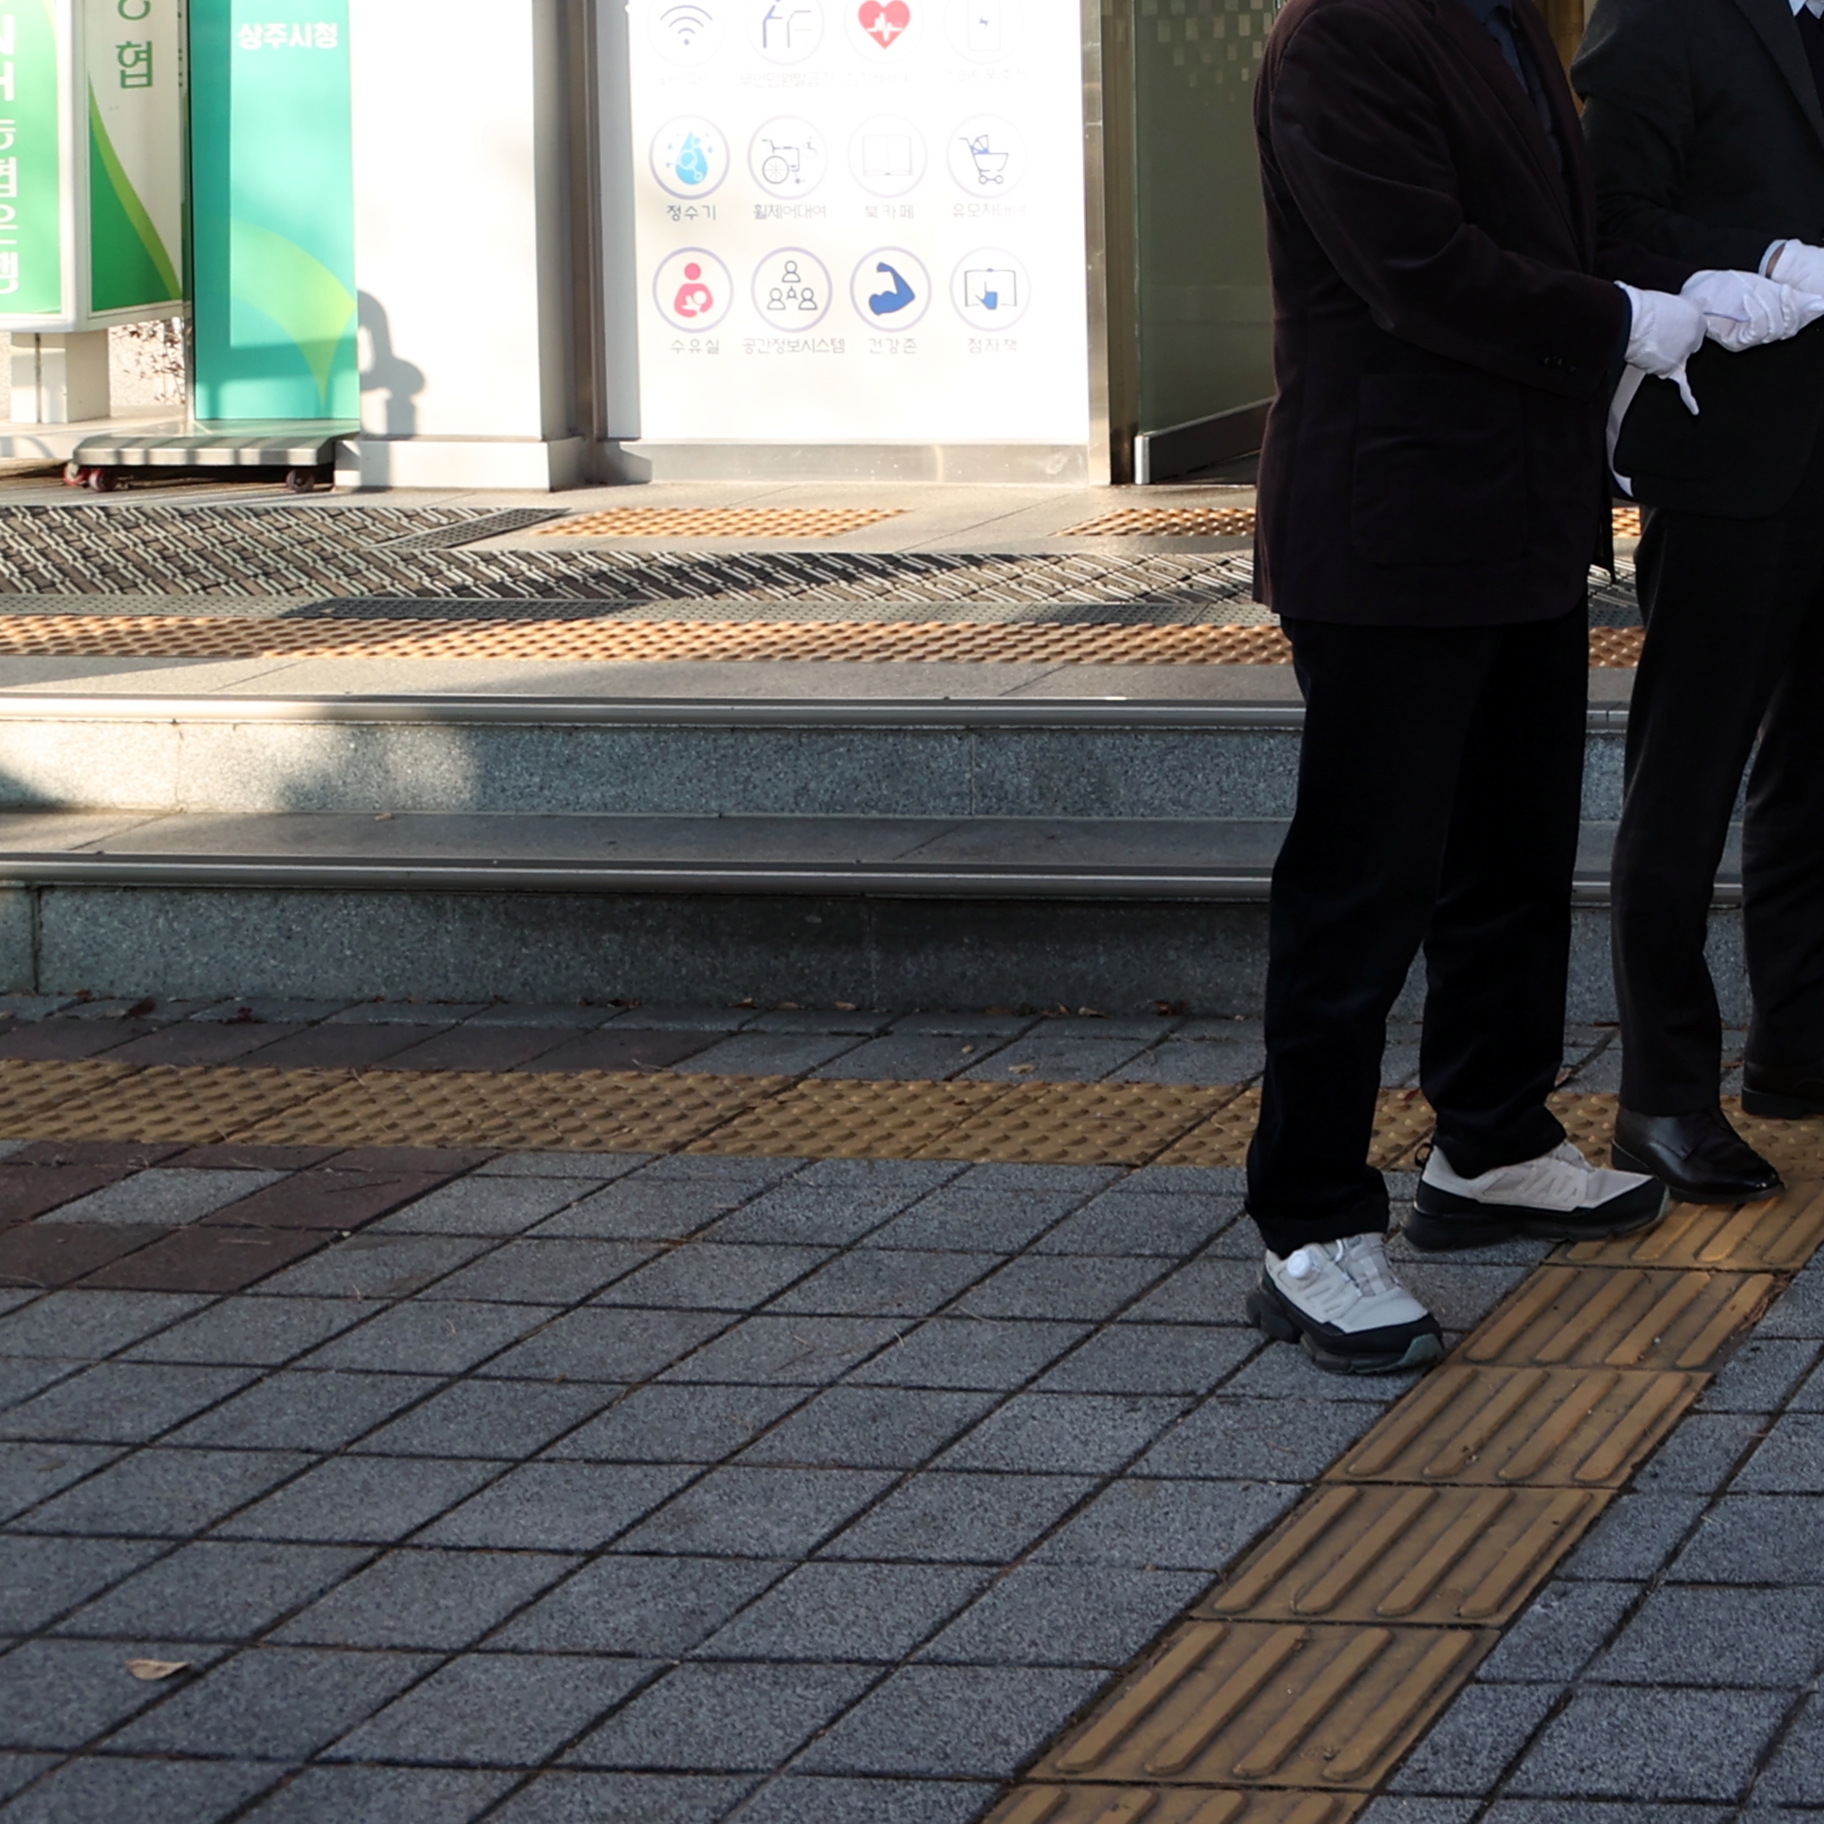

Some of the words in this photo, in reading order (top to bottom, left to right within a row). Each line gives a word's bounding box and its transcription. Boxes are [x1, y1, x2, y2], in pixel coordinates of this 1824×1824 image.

[237, 22, 339, 50] 상주시청
[666, 203, 717, 222] 정수기
[752, 203, 827, 221] 휠체어대여
[670, 337, 720, 354] 수유실
[741, 337, 846, 355] 공간정보시스템
[867, 337, 918, 354] 건강존
[966, 337, 1018, 354] 점자책
